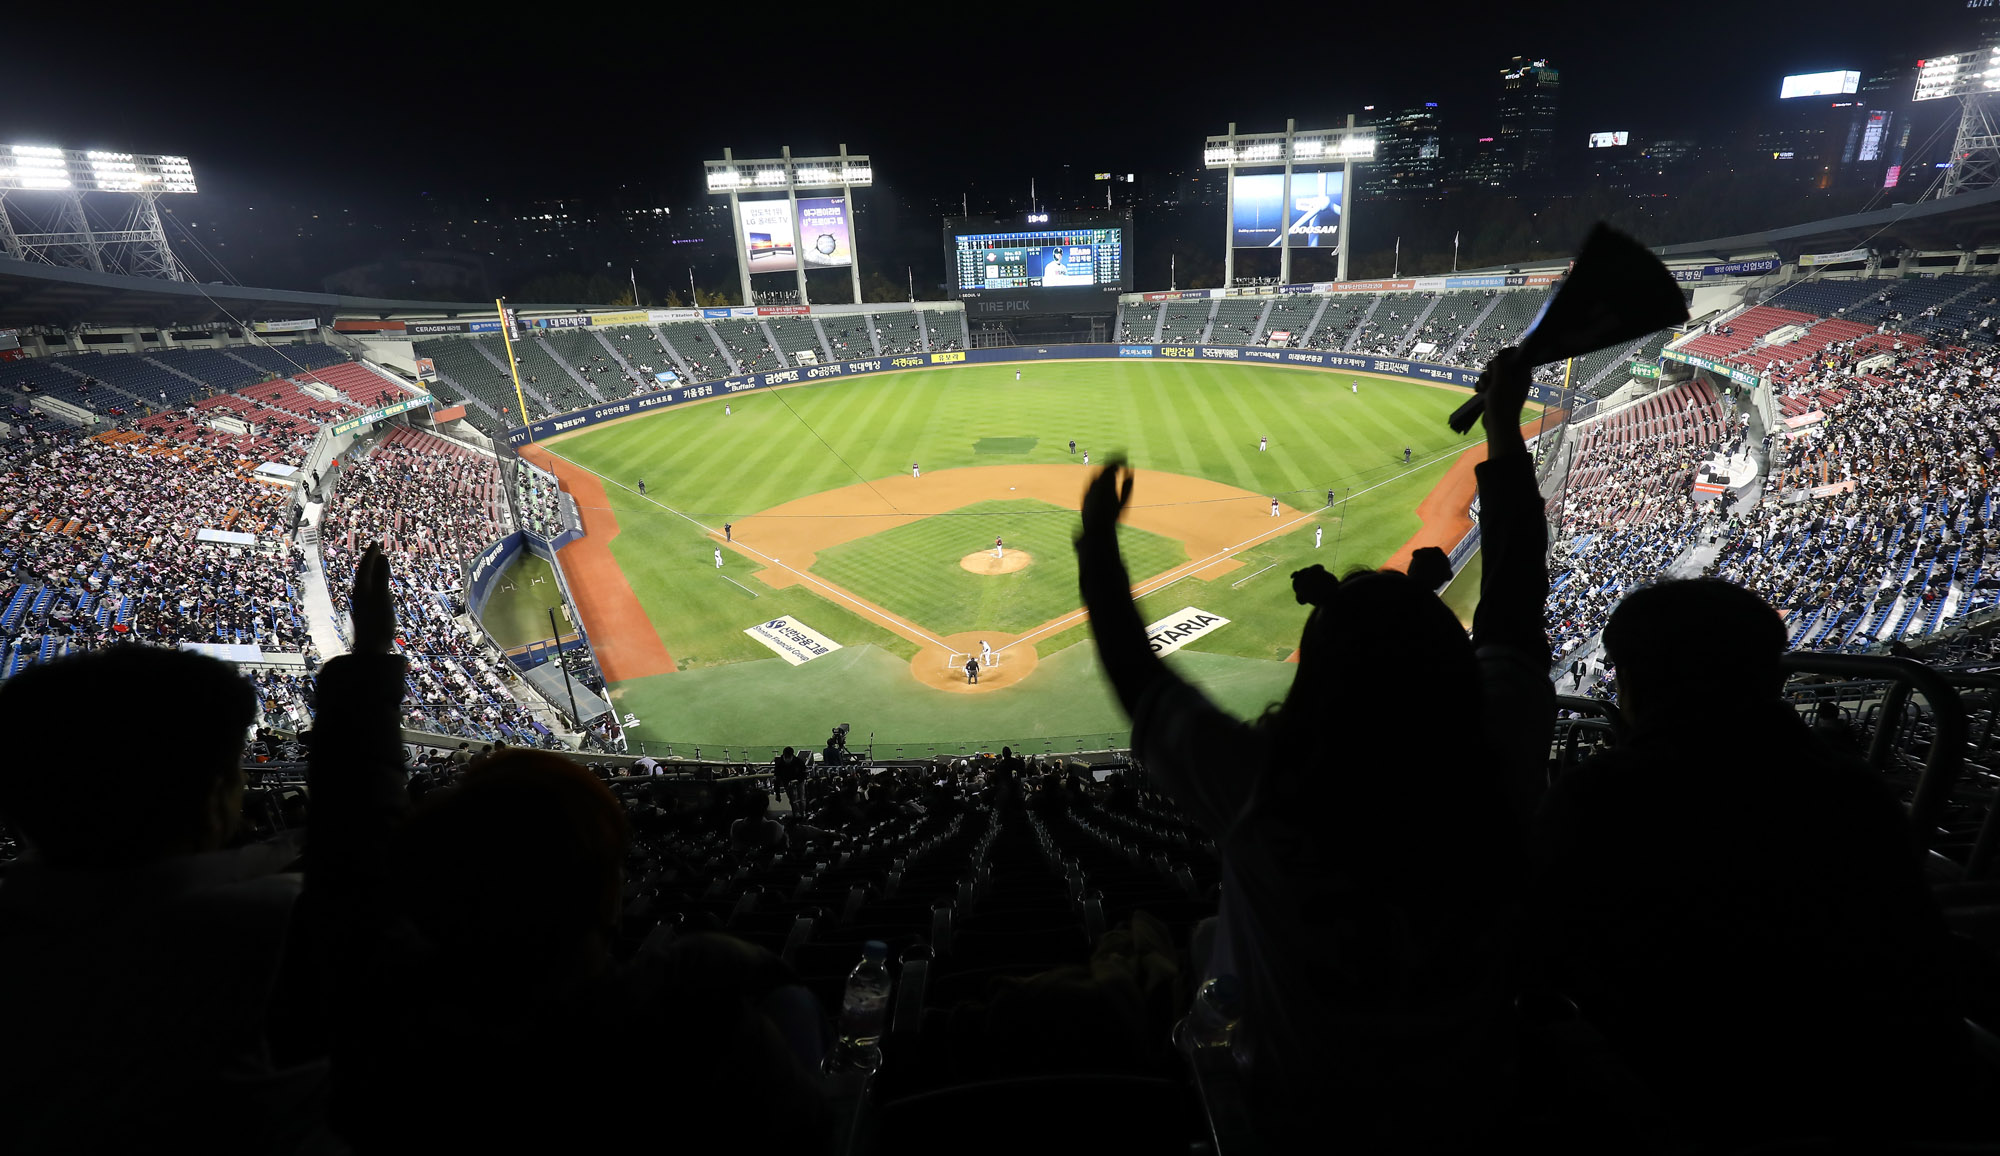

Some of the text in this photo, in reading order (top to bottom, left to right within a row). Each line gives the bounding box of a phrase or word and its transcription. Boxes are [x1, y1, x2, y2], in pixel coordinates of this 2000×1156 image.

[1291, 225, 1338, 234] DOOSAN
[1742, 261, 1773, 272] 신협보험
[978, 300, 1030, 312] TIRE PICK
[550, 317, 587, 327] 대화제약
[415, 325, 446, 333] CERAGEM
[1161, 347, 1195, 357] 대방건설
[891, 357, 924, 368] 서경대학교
[1288, 353, 1323, 363] 미래에셋증권
[817, 364, 842, 377] 금강주택
[849, 360, 881, 373] 현대해상
[765, 370, 799, 385] 금성백조
[683, 385, 713, 399] 키움증권
[731, 382, 756, 392] Buffalo
[602, 404, 630, 416] 유안타증권
[753, 625, 810, 662] Shinhan Financial Group
[778, 626, 830, 656] 신한금융그룹
